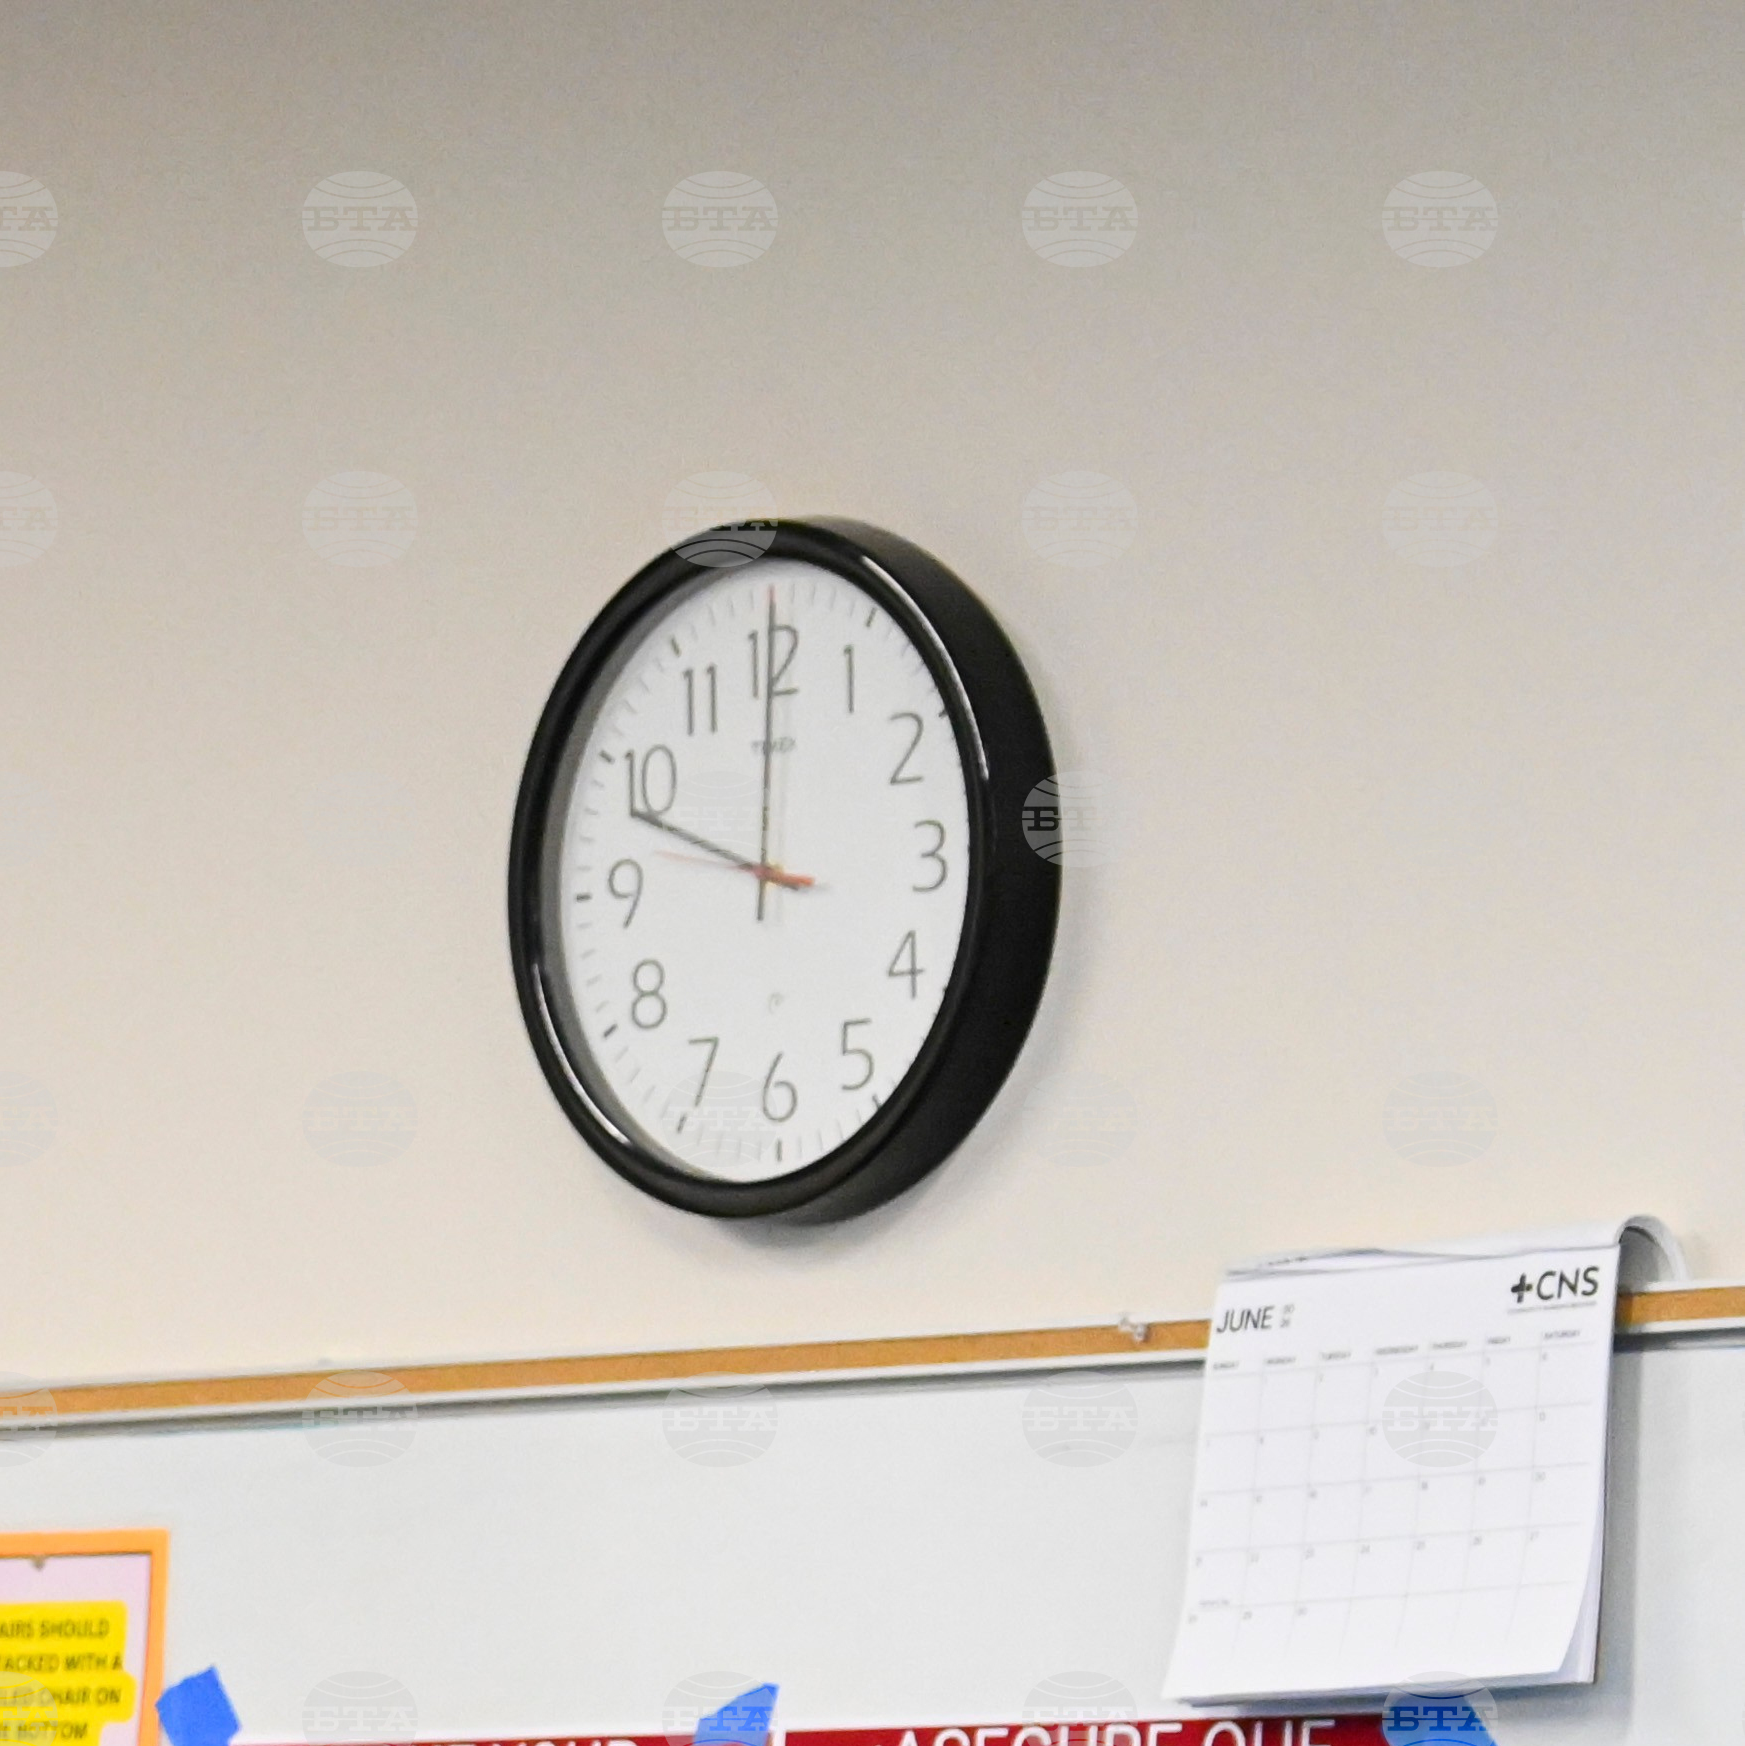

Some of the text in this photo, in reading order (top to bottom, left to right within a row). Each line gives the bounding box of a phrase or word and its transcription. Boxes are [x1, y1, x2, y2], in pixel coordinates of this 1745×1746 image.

[748, 624, 800, 700] 12
[843, 644, 855, 714] 1
[682, 662, 718, 737] 11
[624, 743, 678, 816] 10
[888, 712, 926, 785] 2
[912, 820, 948, 892] 3
[608, 858, 644, 929] 9
[631, 959, 667, 1030] 8
[887, 929, 925, 999] 4
[688, 1035, 720, 1107] 7
[763, 1051, 798, 1123] 6
[842, 1018, 875, 1091] 5
[1216, 1305, 1275, 1334] JUNE
[39, 1617, 110, 1639] SHOULD
[65, 1651, 108, 1672] WITH
[112, 1651, 123, 1671] A
[16, 1720, 89, 1741] BOTTOM
[39, 1686, 92, 1705] CHAIR
[96, 1687, 122, 1706] ON
